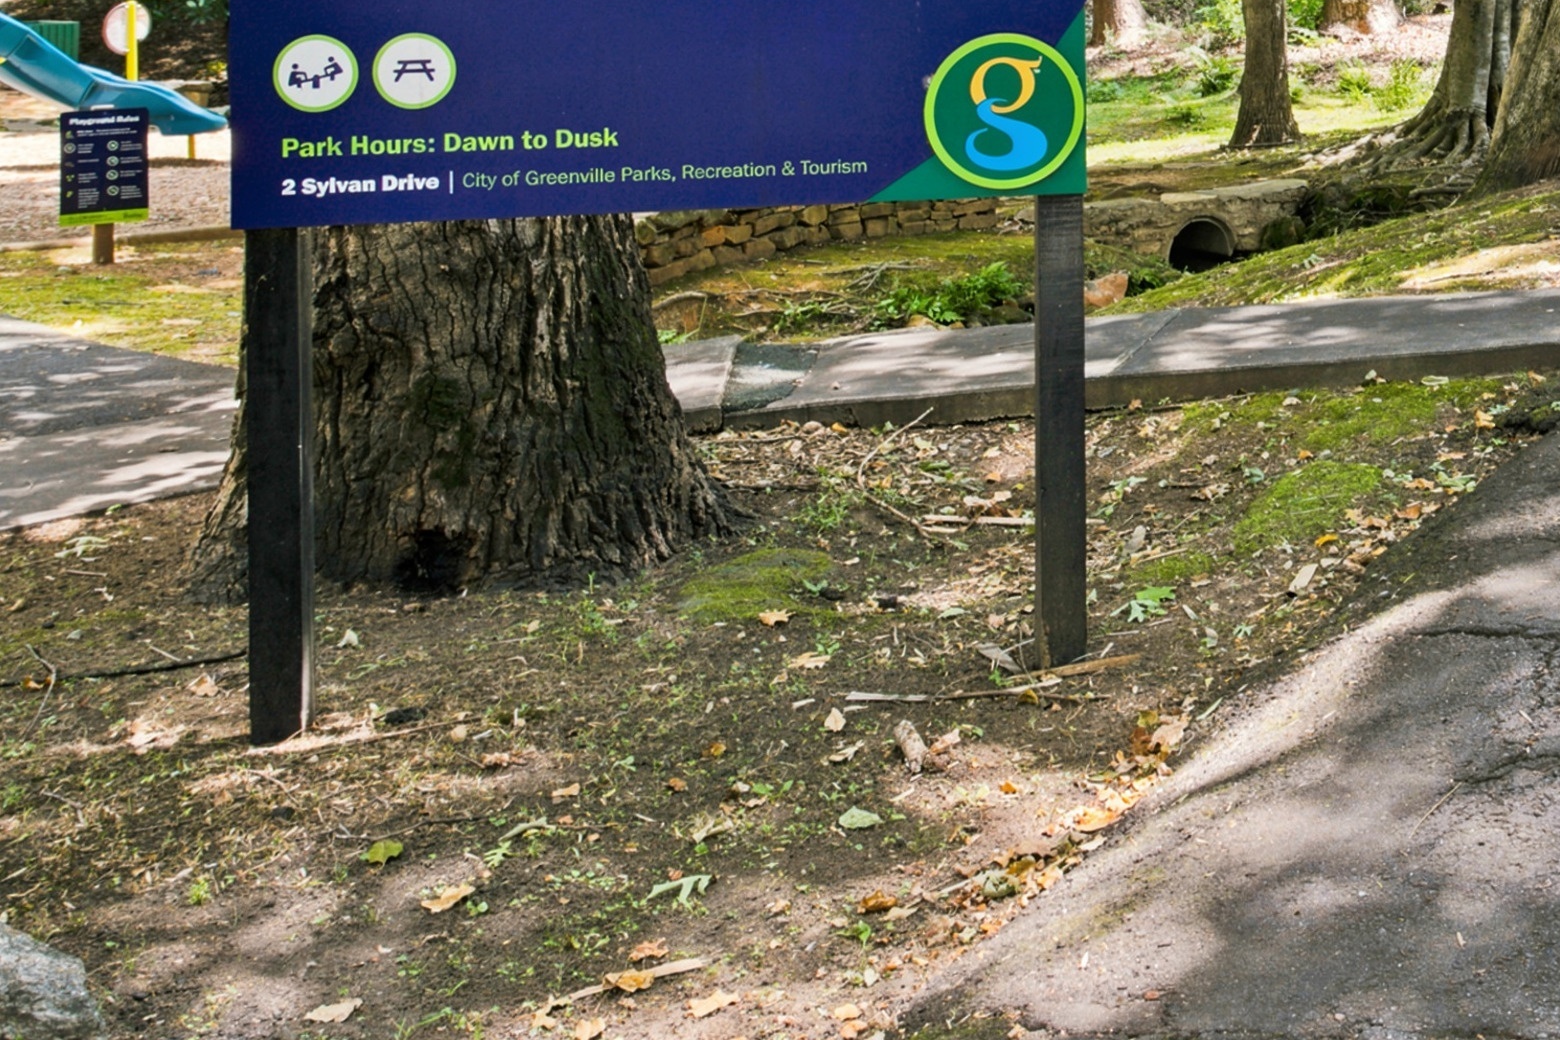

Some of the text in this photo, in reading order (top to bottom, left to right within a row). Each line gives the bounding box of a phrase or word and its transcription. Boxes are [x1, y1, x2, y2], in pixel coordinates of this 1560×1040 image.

[69, 116, 115, 126] Playground
[281, 127, 619, 158] Park Hours: Dawn to Dusk
[281, 158, 868, 198] 2 Sylvan Drive City of Greenville Parks, Recreation & Tourism
